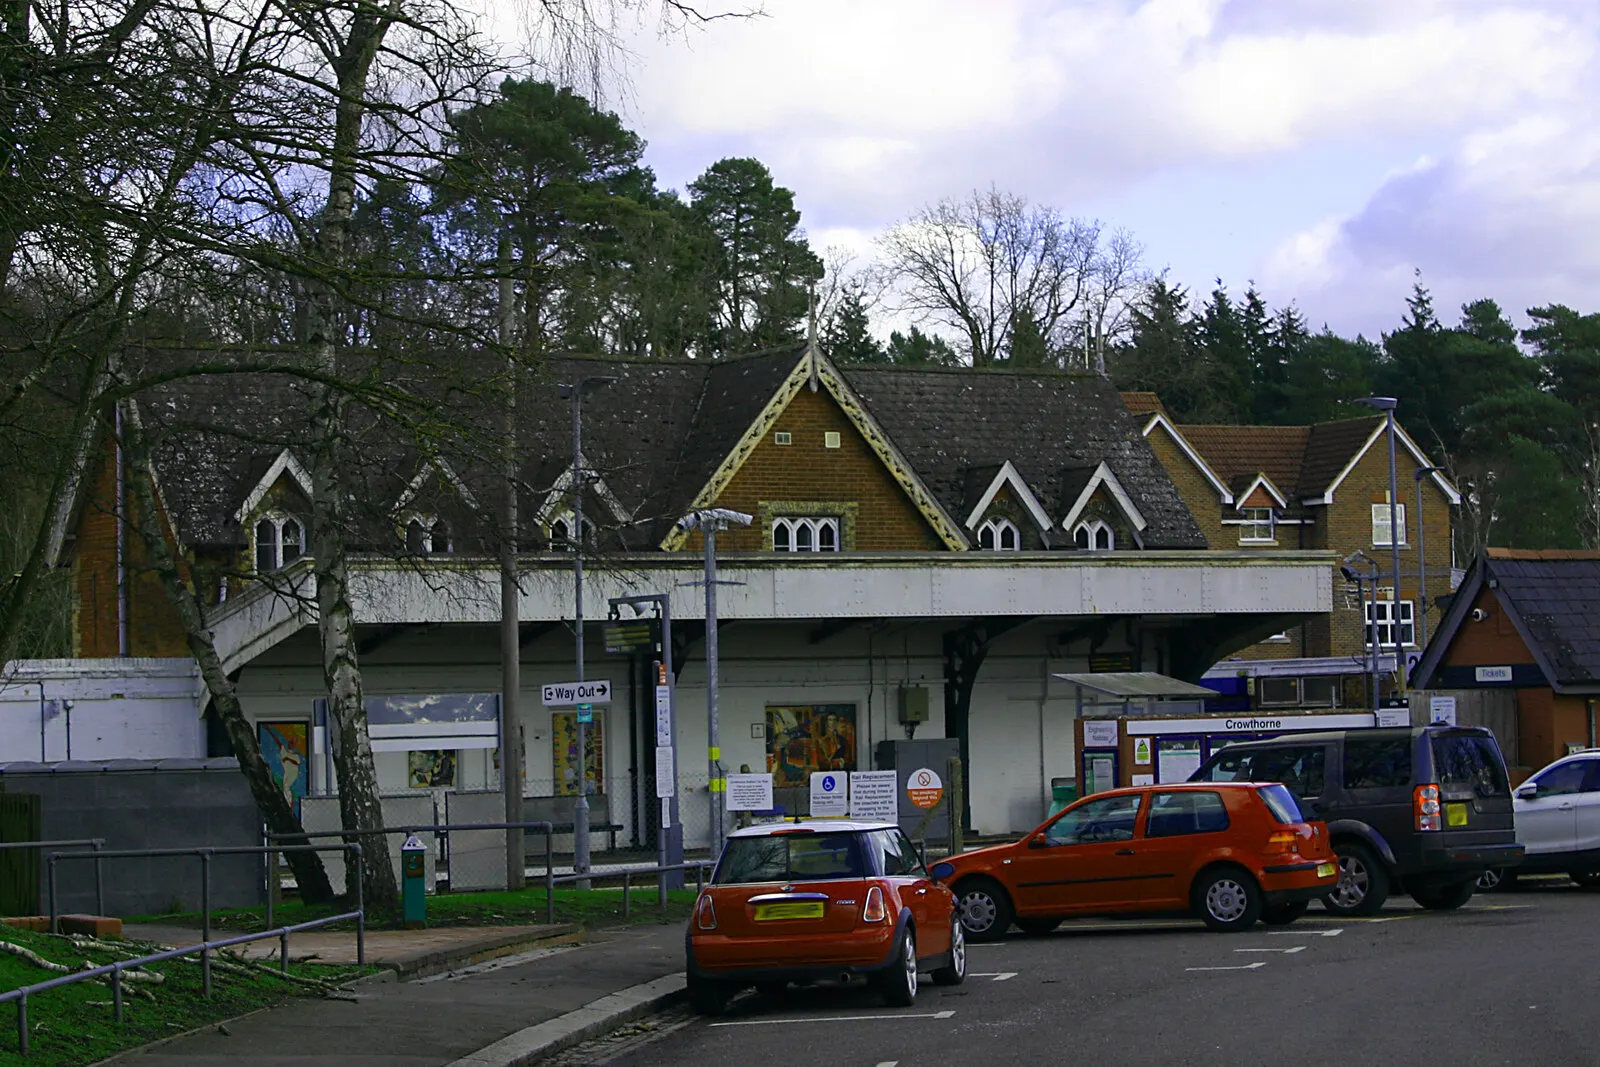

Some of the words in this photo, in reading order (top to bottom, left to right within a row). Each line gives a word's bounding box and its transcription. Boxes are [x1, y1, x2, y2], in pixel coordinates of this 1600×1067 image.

[1482, 669, 1506, 678] Tickets
[555, 687, 575, 701] Way
[578, 686, 595, 698] Out
[1225, 719, 1281, 729] Crowthorne
[862, 772, 895, 780] Replacement
